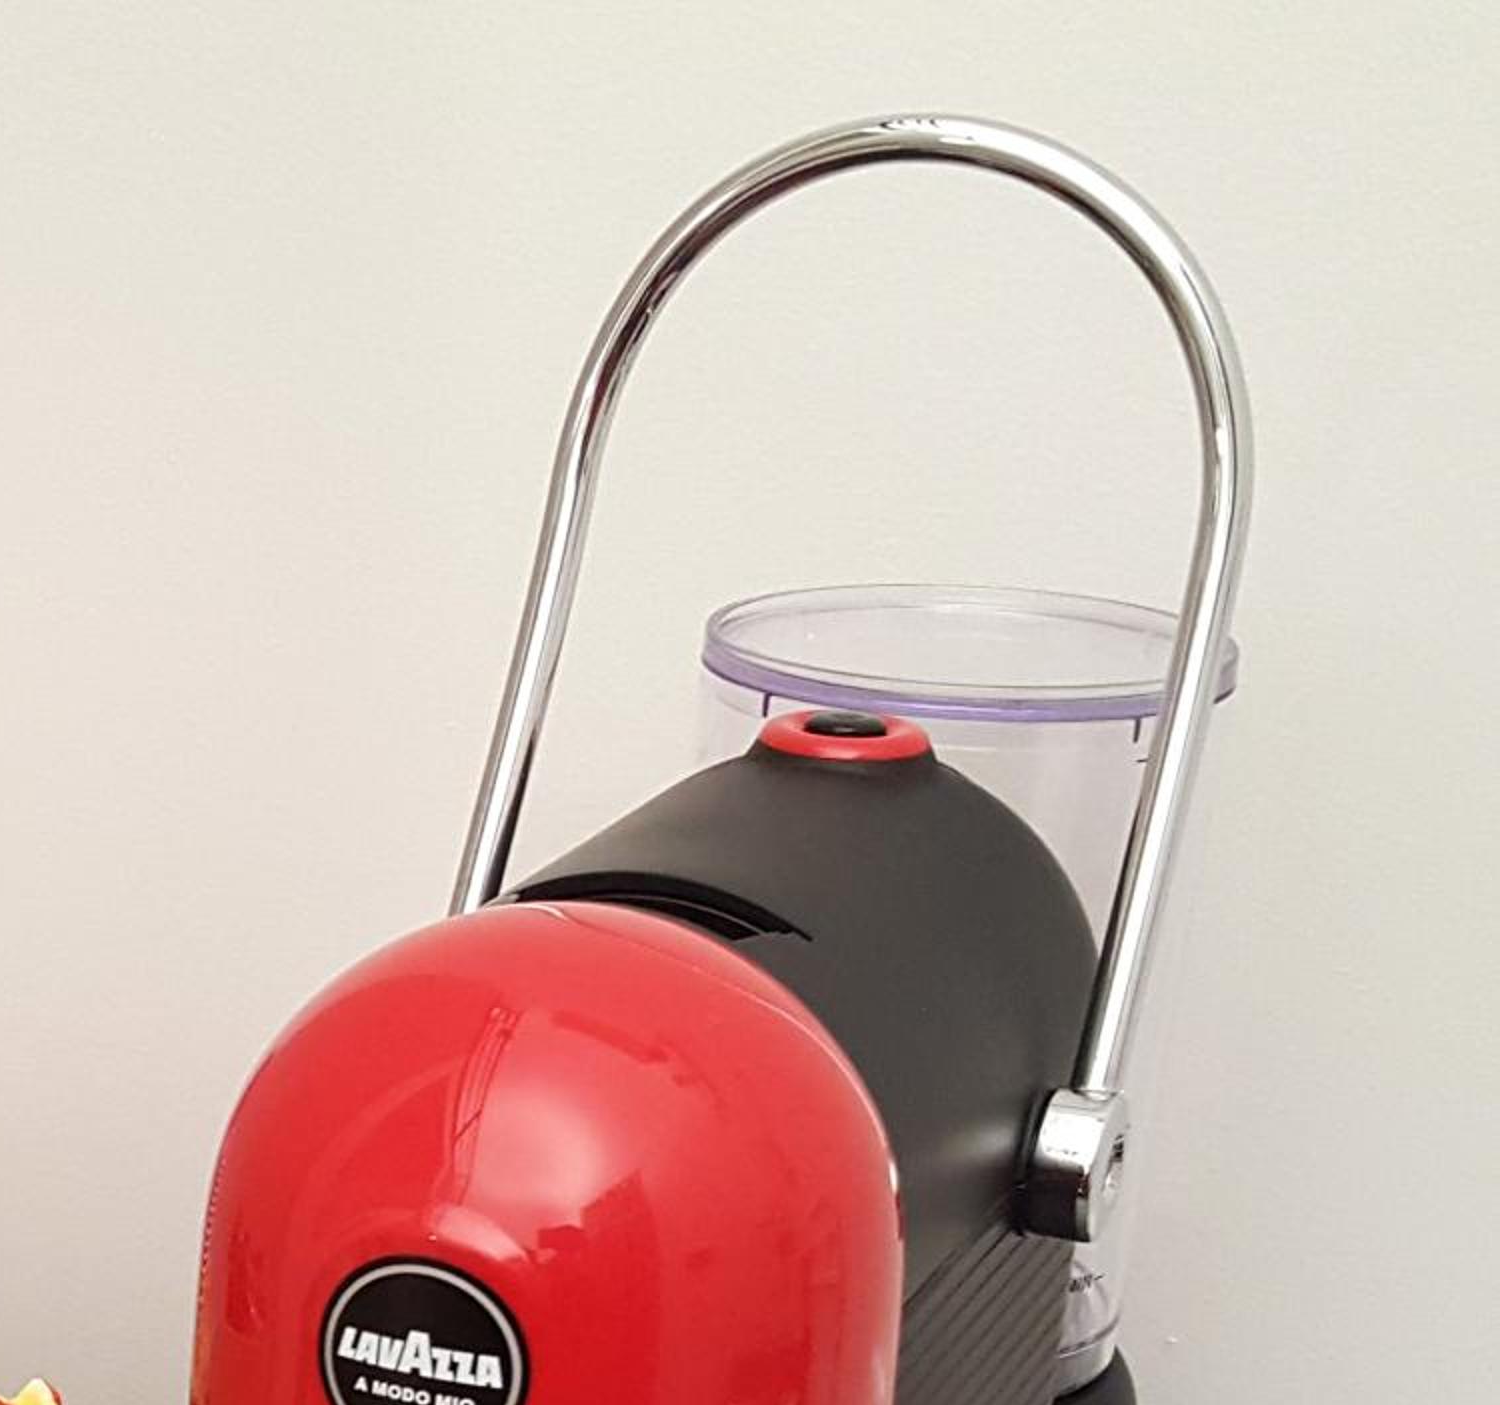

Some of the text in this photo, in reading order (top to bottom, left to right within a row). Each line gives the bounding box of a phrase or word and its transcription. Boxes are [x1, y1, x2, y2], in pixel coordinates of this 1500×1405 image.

[337, 1325, 504, 1389] LAVAZZA
[353, 1376, 368, 1392] A
[371, 1380, 431, 1405] MODO
